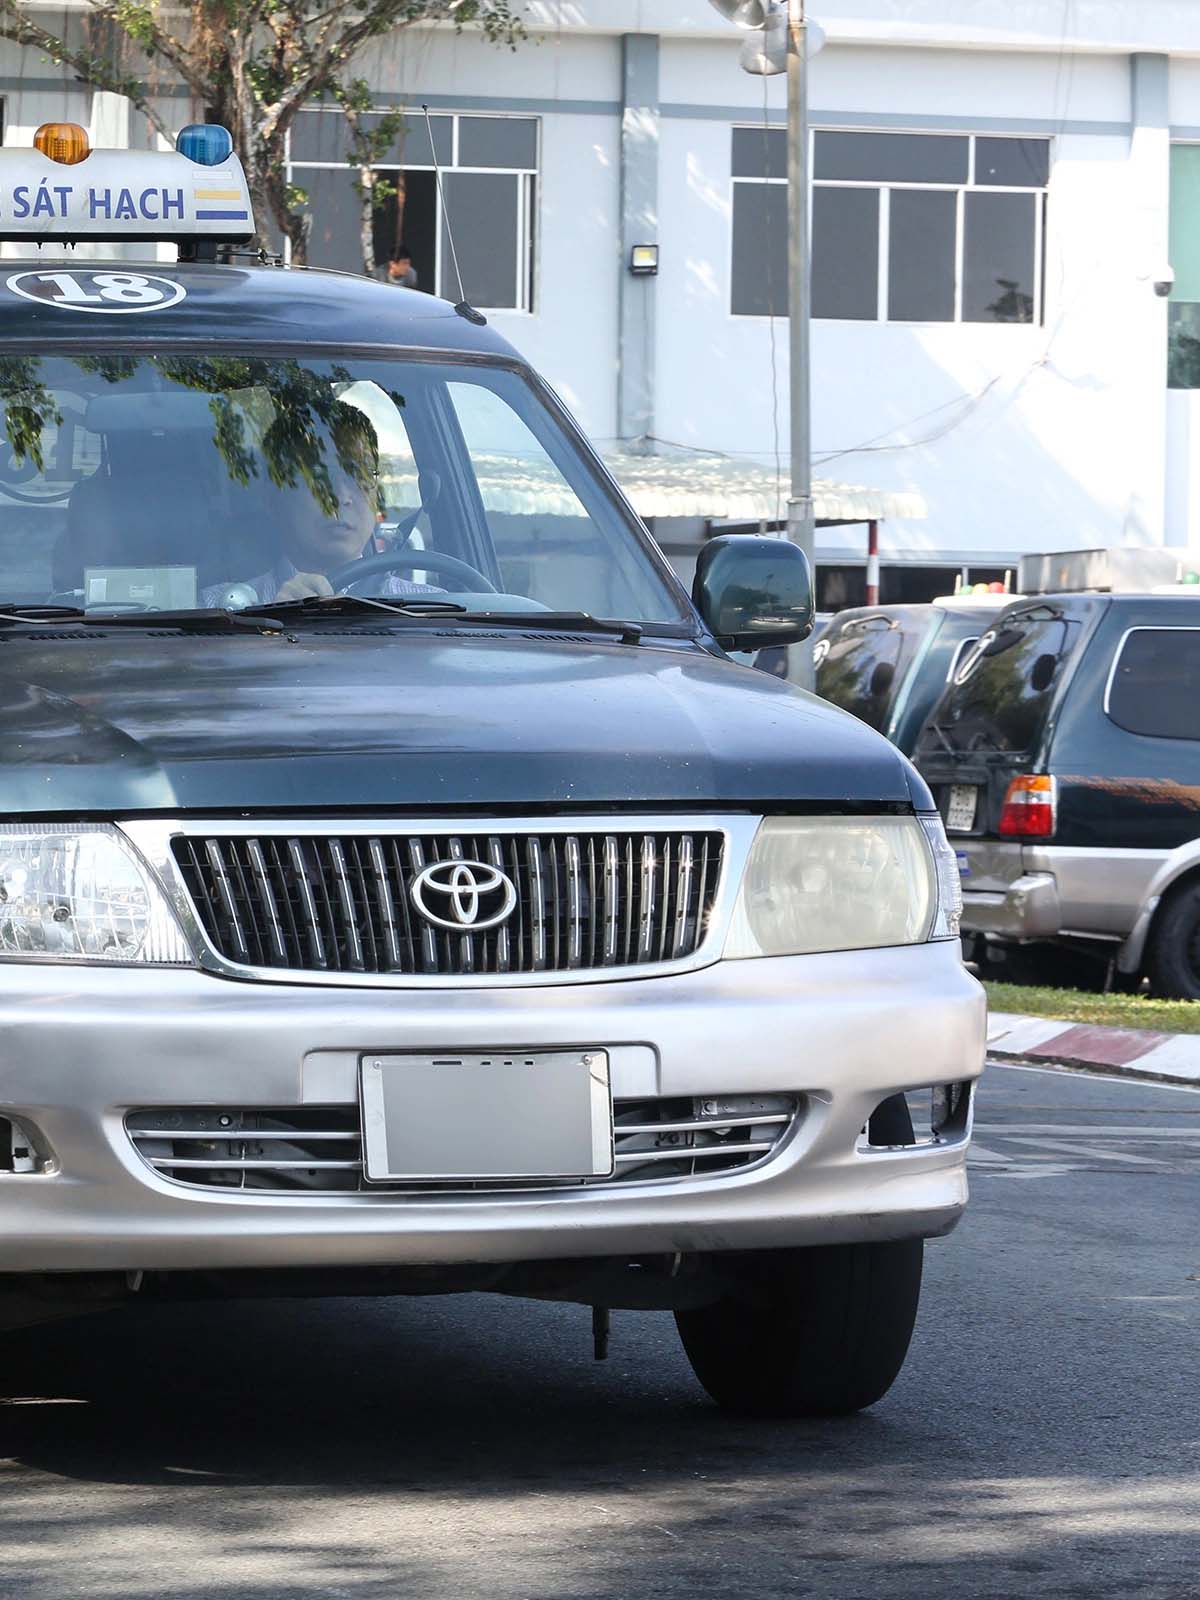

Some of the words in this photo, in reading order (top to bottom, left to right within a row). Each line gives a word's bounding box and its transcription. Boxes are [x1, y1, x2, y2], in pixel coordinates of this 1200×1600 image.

[13, 177, 73, 218] SÁT
[89, 188, 185, 220] HẠCH
[36, 272, 164, 304] 18
